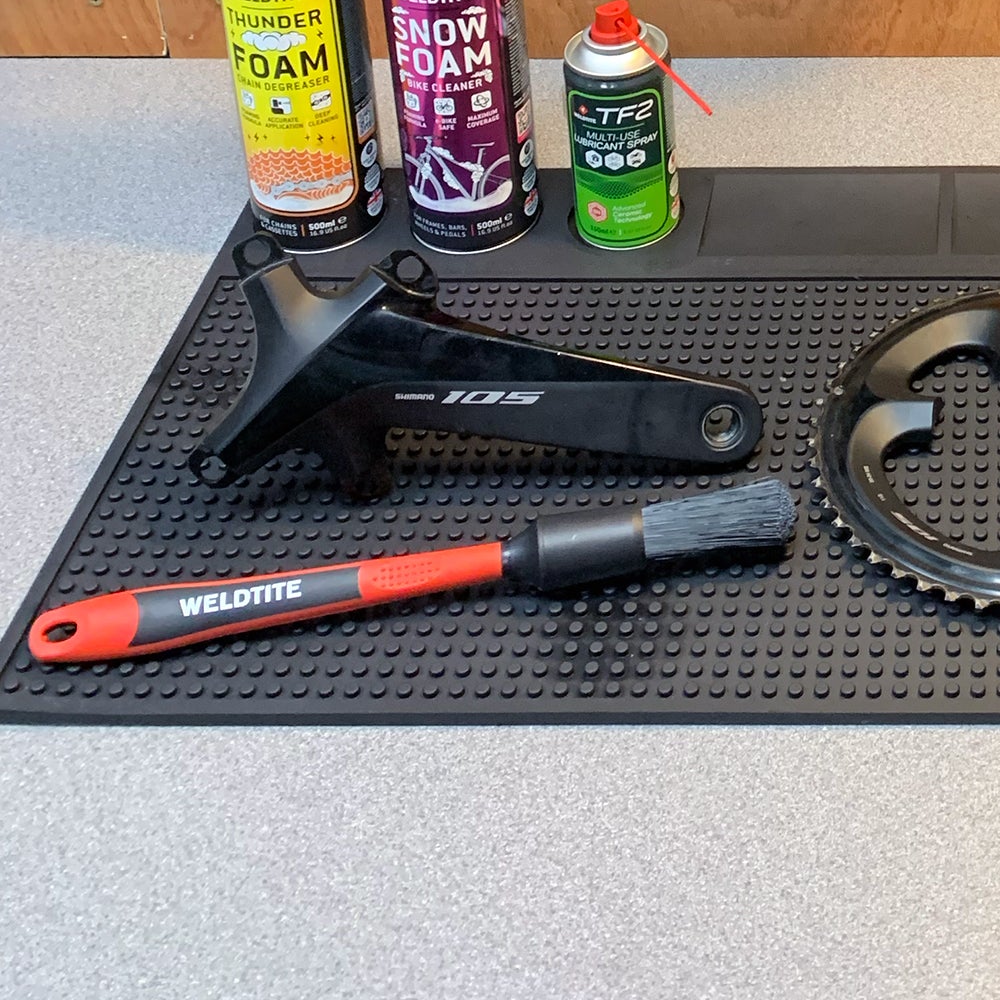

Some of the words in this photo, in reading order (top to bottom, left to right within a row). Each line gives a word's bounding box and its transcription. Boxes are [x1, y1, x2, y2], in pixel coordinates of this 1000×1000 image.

[227, 7, 323, 29] THUNDER
[393, 14, 488, 46] SNOW
[232, 42, 329, 80] FOAM
[395, 41, 492, 79] FOAM
[237, 74, 262, 89] CHAIN
[264, 75, 330, 92] DEGREASER
[407, 79, 429, 92] BIKE
[431, 79, 483, 93] CLEANER
[467, 108, 498, 122] MAXIMUM
[595, 98, 654, 125] TF2
[466, 113, 500, 129] COVERAGE
[573, 132, 625, 151] LUBRICANT
[626, 130, 659, 149] SPRAY
[586, 129, 641, 142] MULTI-USE
[308, 219, 336, 231] 500ml
[476, 217, 503, 230] 500ml
[394, 393, 435, 401] SHIMANO
[441, 390, 545, 405] 105
[179, 578, 302, 617] WELDTITE
